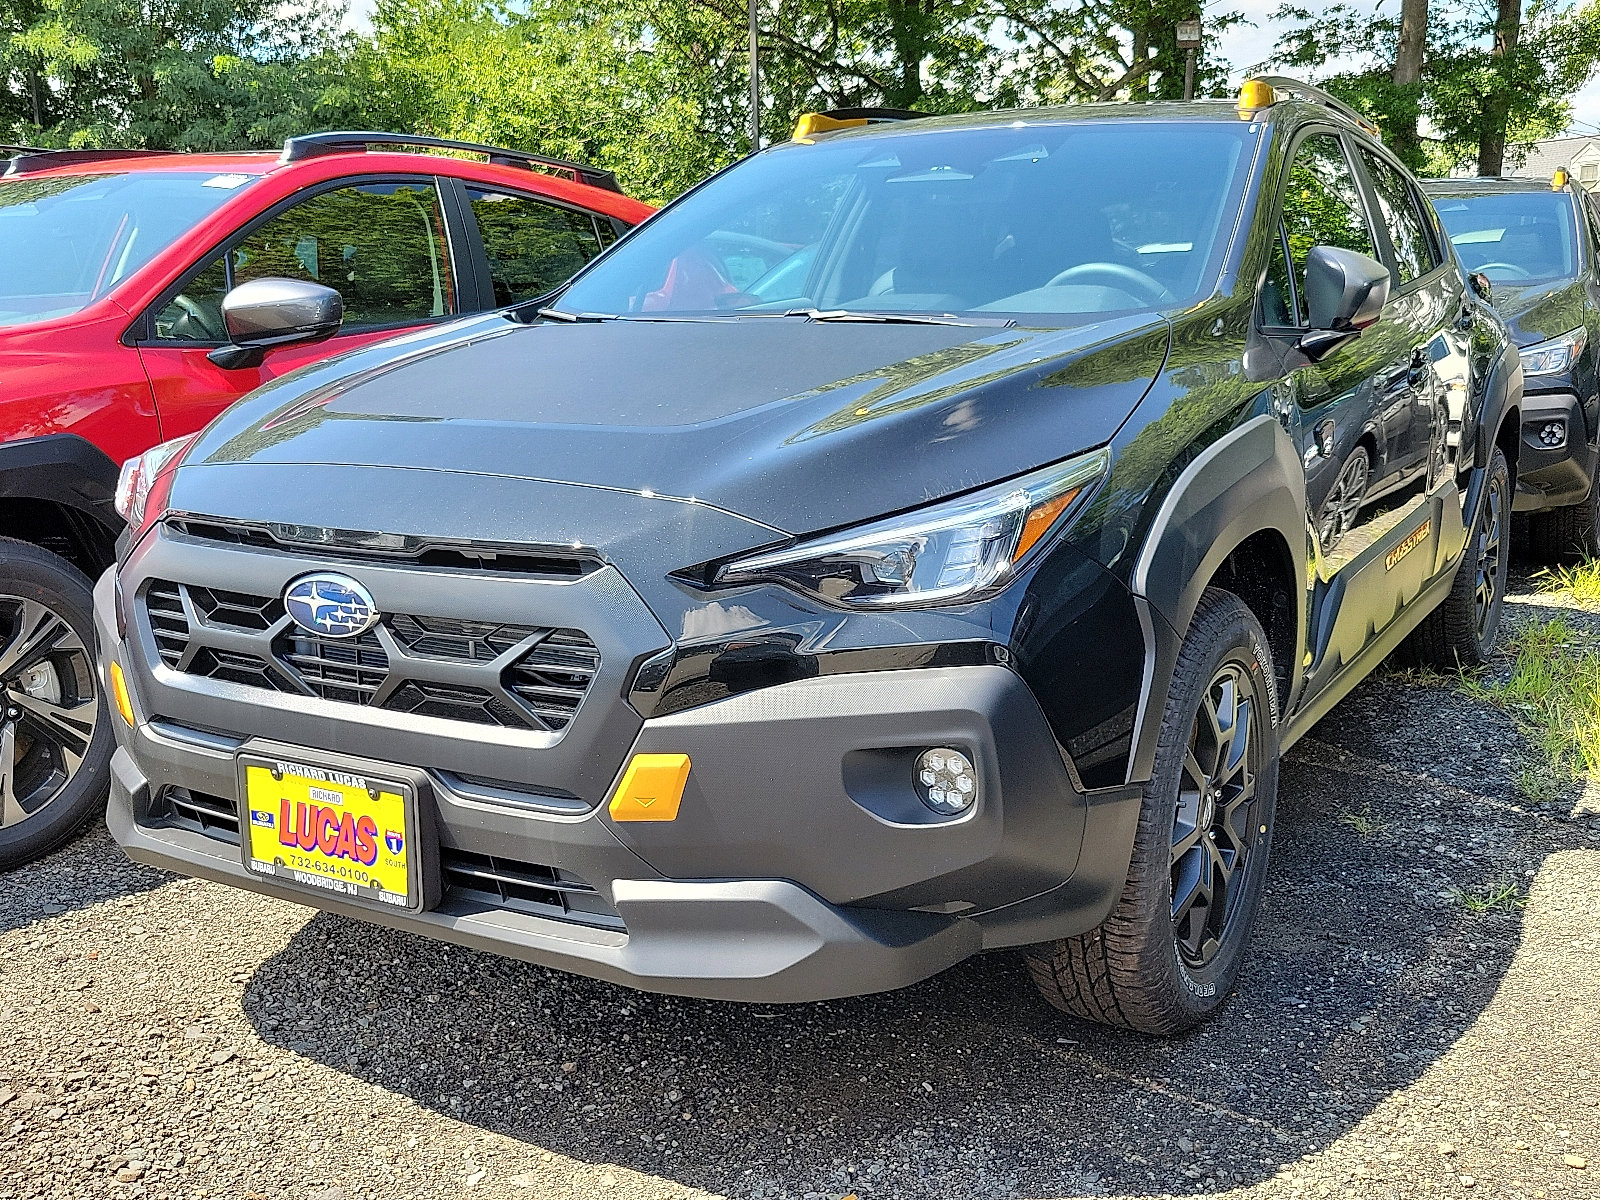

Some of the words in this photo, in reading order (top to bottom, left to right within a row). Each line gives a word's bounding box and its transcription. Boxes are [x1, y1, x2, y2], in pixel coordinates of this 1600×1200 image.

[1252, 643, 1278, 730] YOKOHAMA
[277, 762, 326, 782] RICHARD
[328, 772, 367, 790] LUCAS
[311, 789, 341, 804] RICHARD
[279, 798, 378, 867] LUCAS
[389, 838, 400, 855] 1
[250, 859, 276, 876] SUBARU
[289, 854, 369, 883] 732-634-0100
[384, 857, 406, 870] SOUTH
[293, 870, 347, 894] WOODBRIDGE,
[347, 883, 359, 896] NJ
[378, 891, 407, 907] SUBARU
